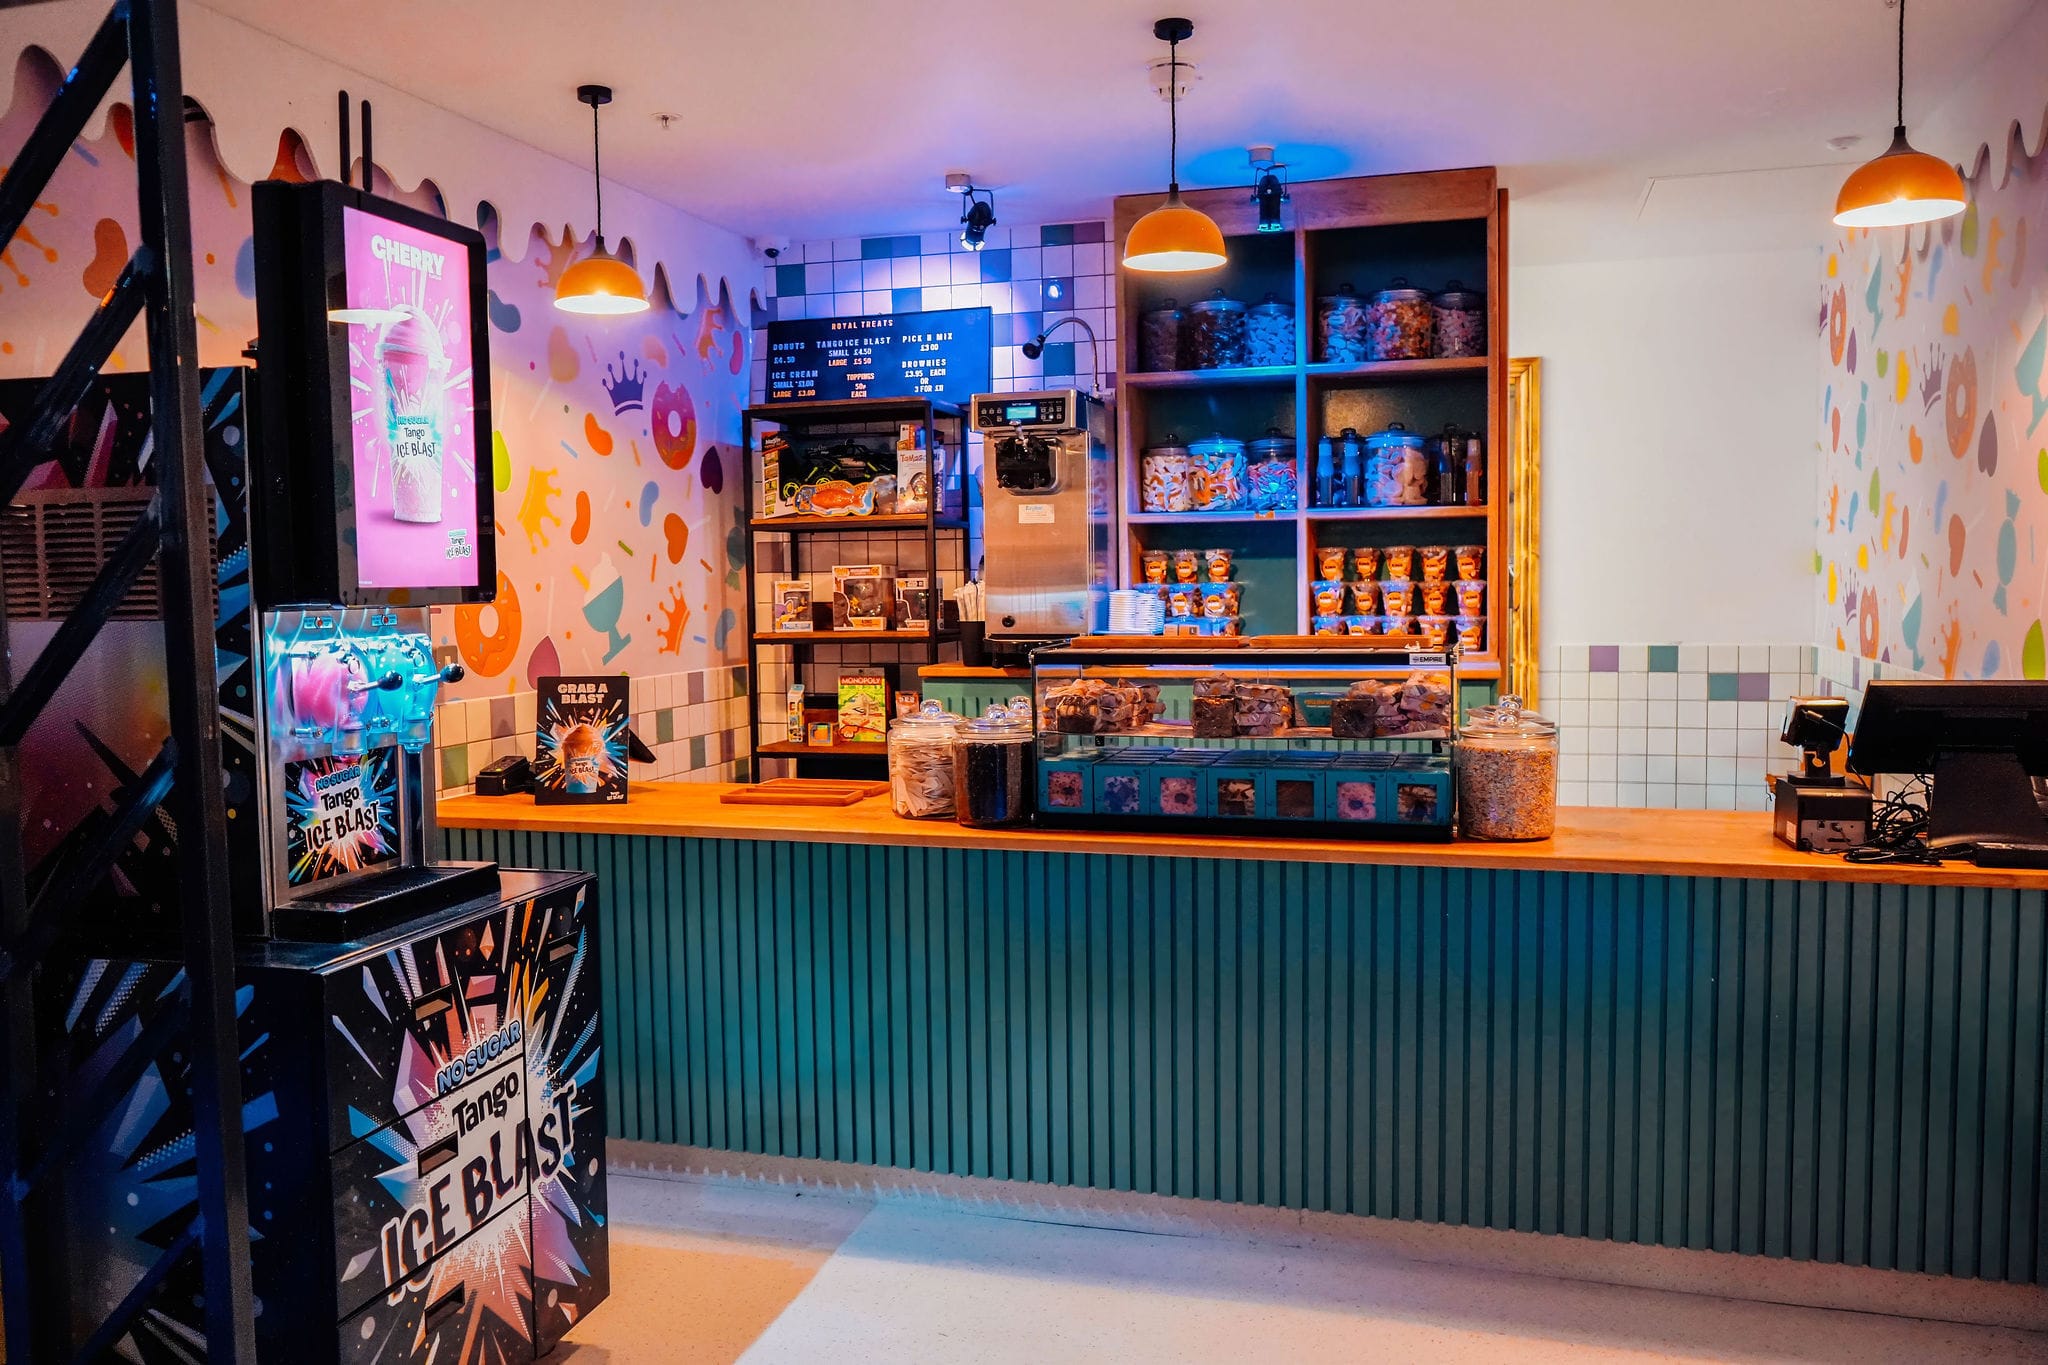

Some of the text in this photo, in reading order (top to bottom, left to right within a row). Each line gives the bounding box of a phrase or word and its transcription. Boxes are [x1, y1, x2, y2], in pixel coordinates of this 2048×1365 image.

[372, 234, 444, 276] CHERRY
[832, 320, 893, 330] ROYAL TREATS
[816, 340, 842, 348] TANGO
[864, 337, 891, 346] BLAST
[902, 335, 922, 343] PICK
[936, 332, 952, 341] MIX
[828, 349, 849, 357] SMALL
[902, 359, 946, 368] BROWNIES
[790, 370, 818, 378] CREAM
[773, 381, 794, 389] SMALL
[404, 428, 425, 440] Tango
[397, 440, 436, 457] ICE BLAST
[558, 683, 608, 694] GRAB A
[561, 694, 605, 704] BLAST
[316, 766, 361, 791] NO SUGAR
[321, 787, 359, 811] Tango
[307, 801, 378, 850] ICE BLAST
[437, 1020, 521, 1094] NO SUGAR
[452, 1072, 519, 1137] Tango
[384, 1086, 574, 1300] ICE BLAST
